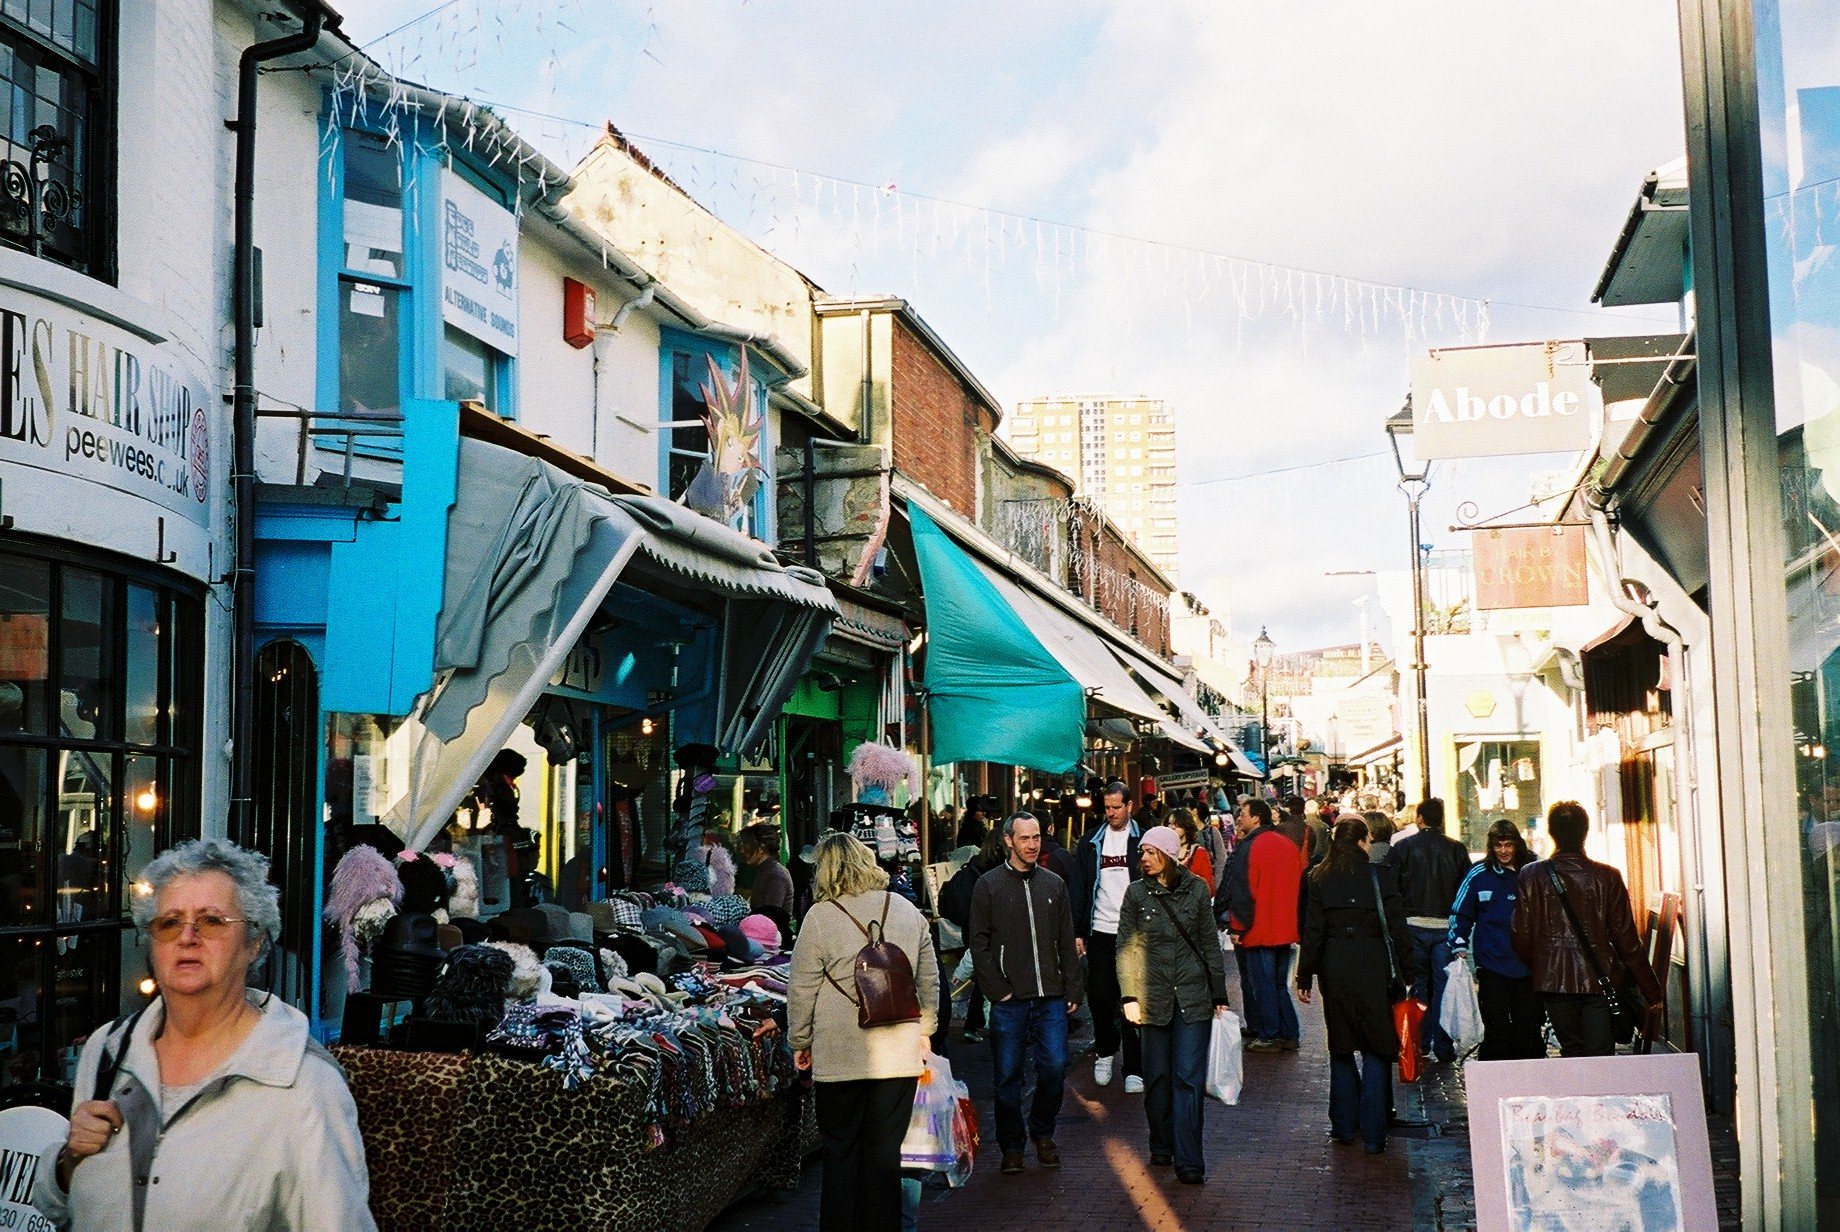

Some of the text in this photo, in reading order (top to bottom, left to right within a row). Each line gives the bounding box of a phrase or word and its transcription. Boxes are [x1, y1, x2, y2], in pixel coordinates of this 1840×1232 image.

[445, 286, 515, 339] ALTERNATIVE SOUNDS
[66, 328, 142, 437] HAIR
[147, 363, 191, 461] SHOP
[1422, 381, 1581, 424] Abode
[66, 426, 189, 498] peewees.c.uk
[1480, 562, 1583, 589] CROWN
